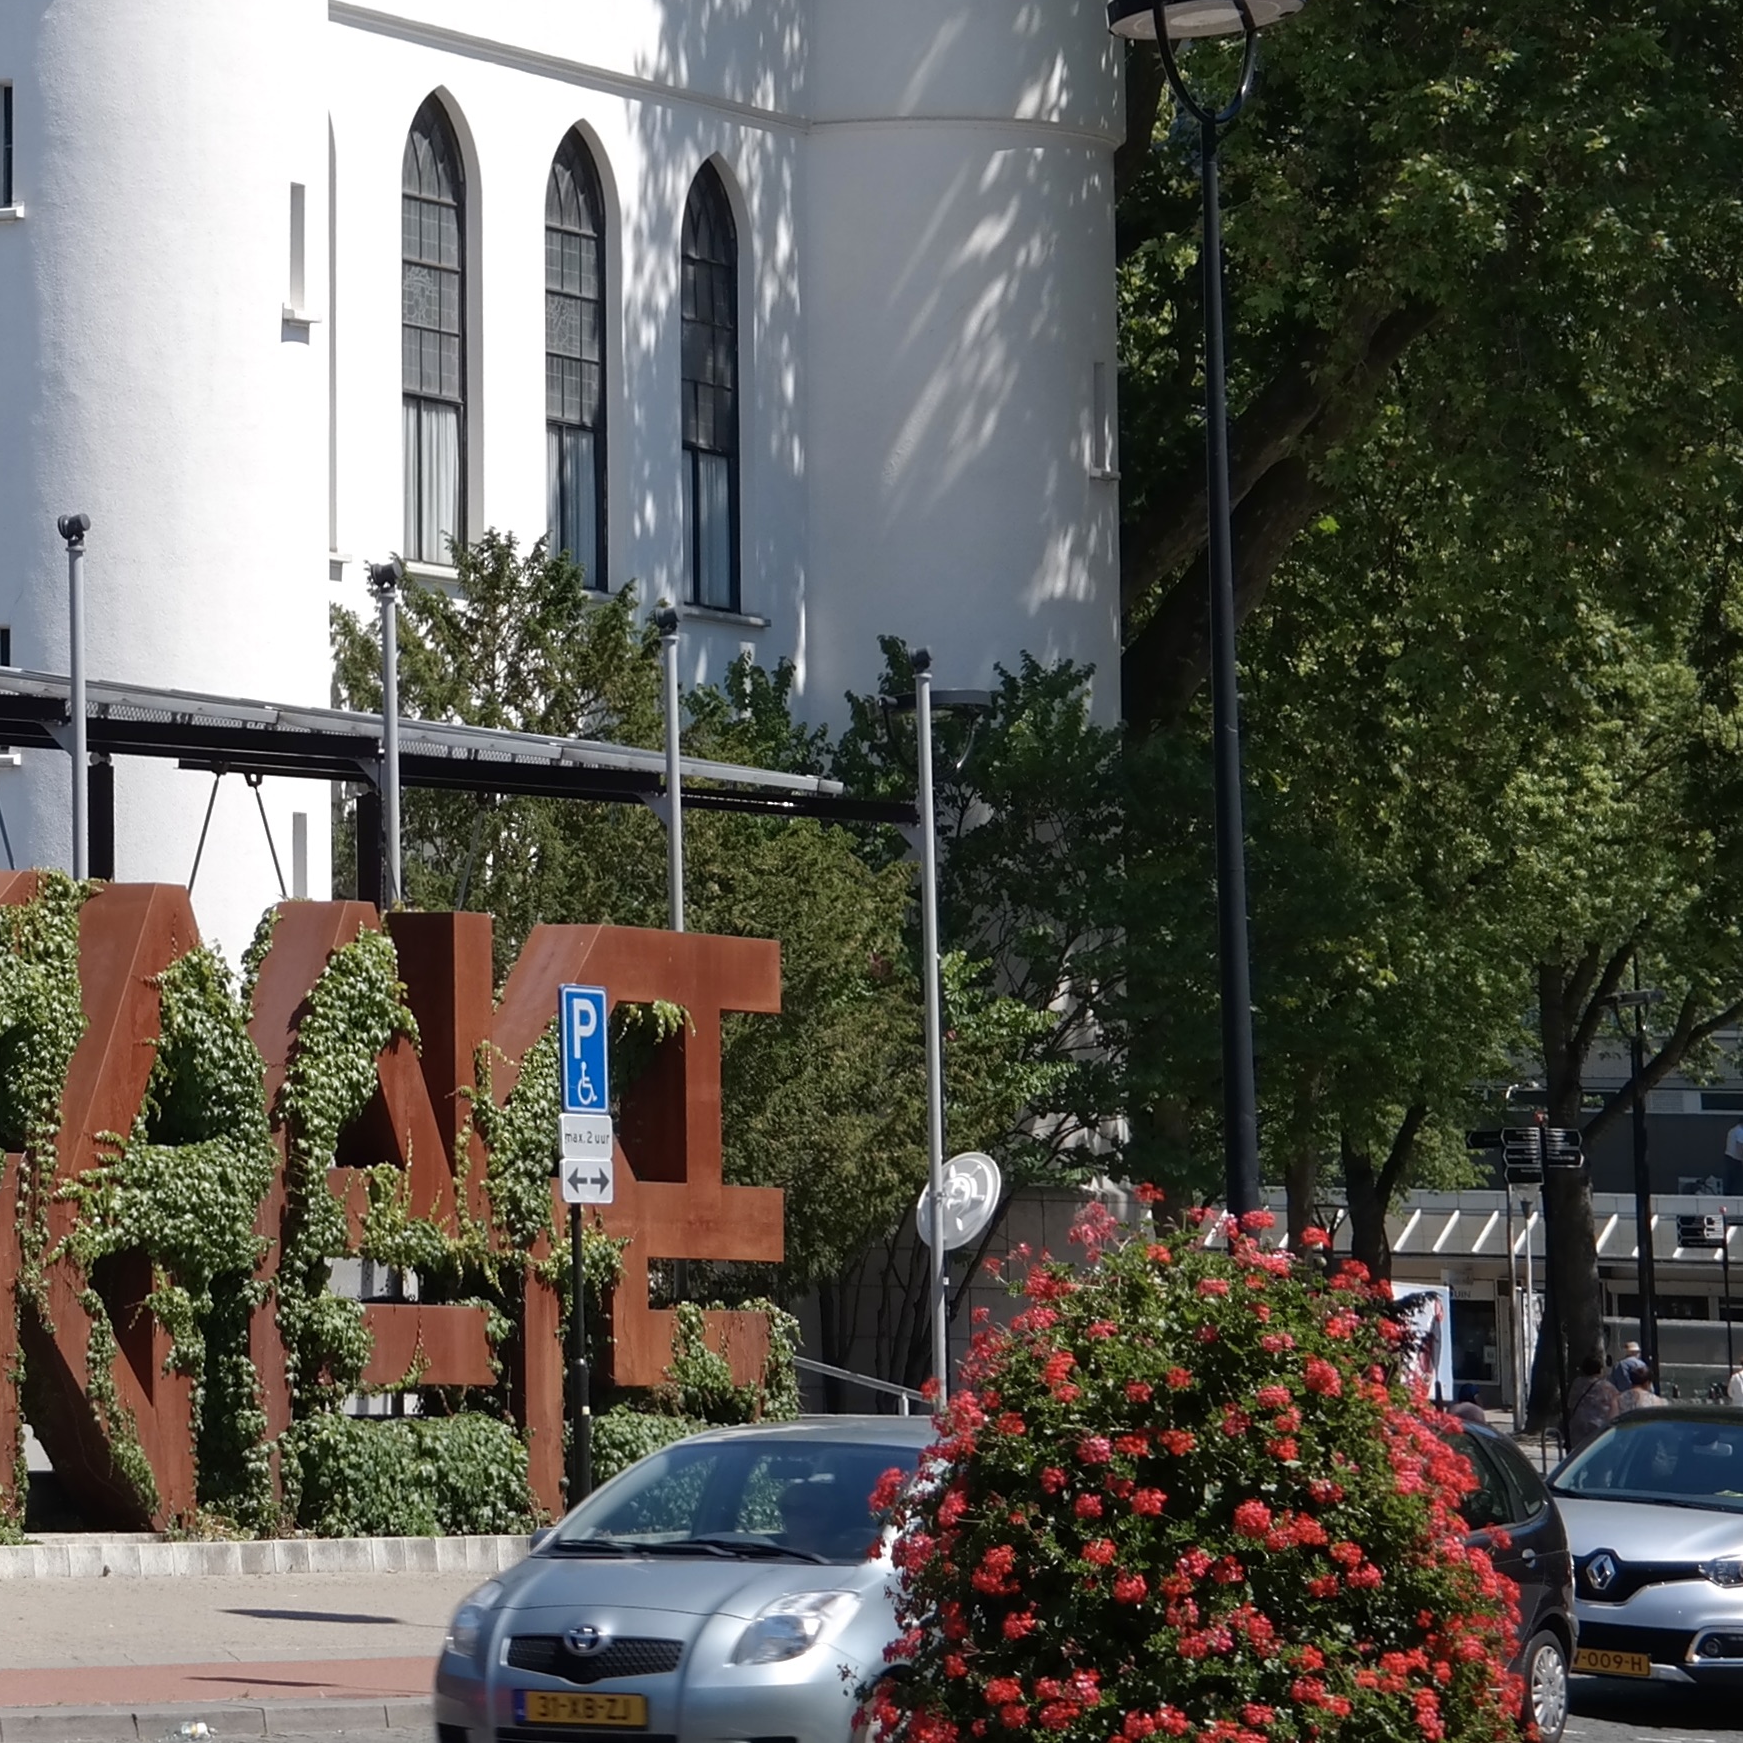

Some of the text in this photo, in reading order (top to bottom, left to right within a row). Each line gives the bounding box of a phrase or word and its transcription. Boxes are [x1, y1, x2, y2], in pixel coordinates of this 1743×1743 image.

[573, 998, 597, 1059] P
[565, 1131, 610, 1145] max. 2 uur
